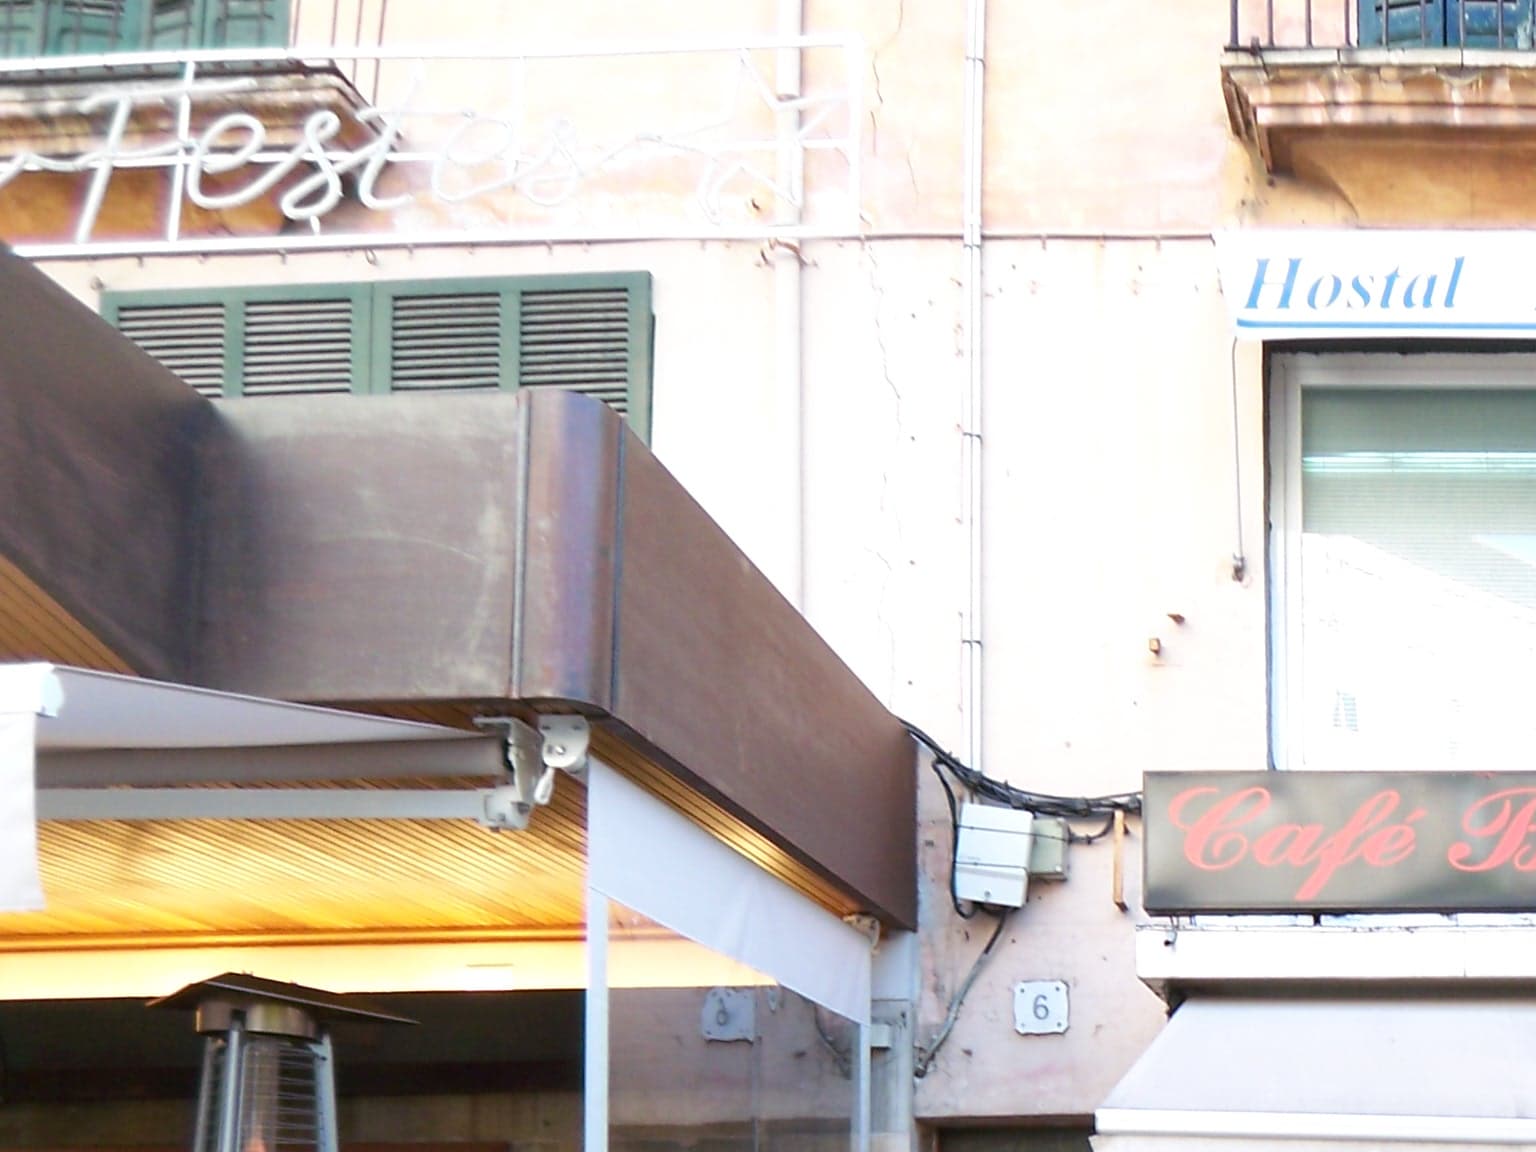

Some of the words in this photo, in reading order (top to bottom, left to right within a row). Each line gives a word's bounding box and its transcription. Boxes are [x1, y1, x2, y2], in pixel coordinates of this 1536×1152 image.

[1244, 255, 1466, 310] Hostal
[1168, 786, 1428, 900] Café
[1033, 994, 1049, 1020] 6
